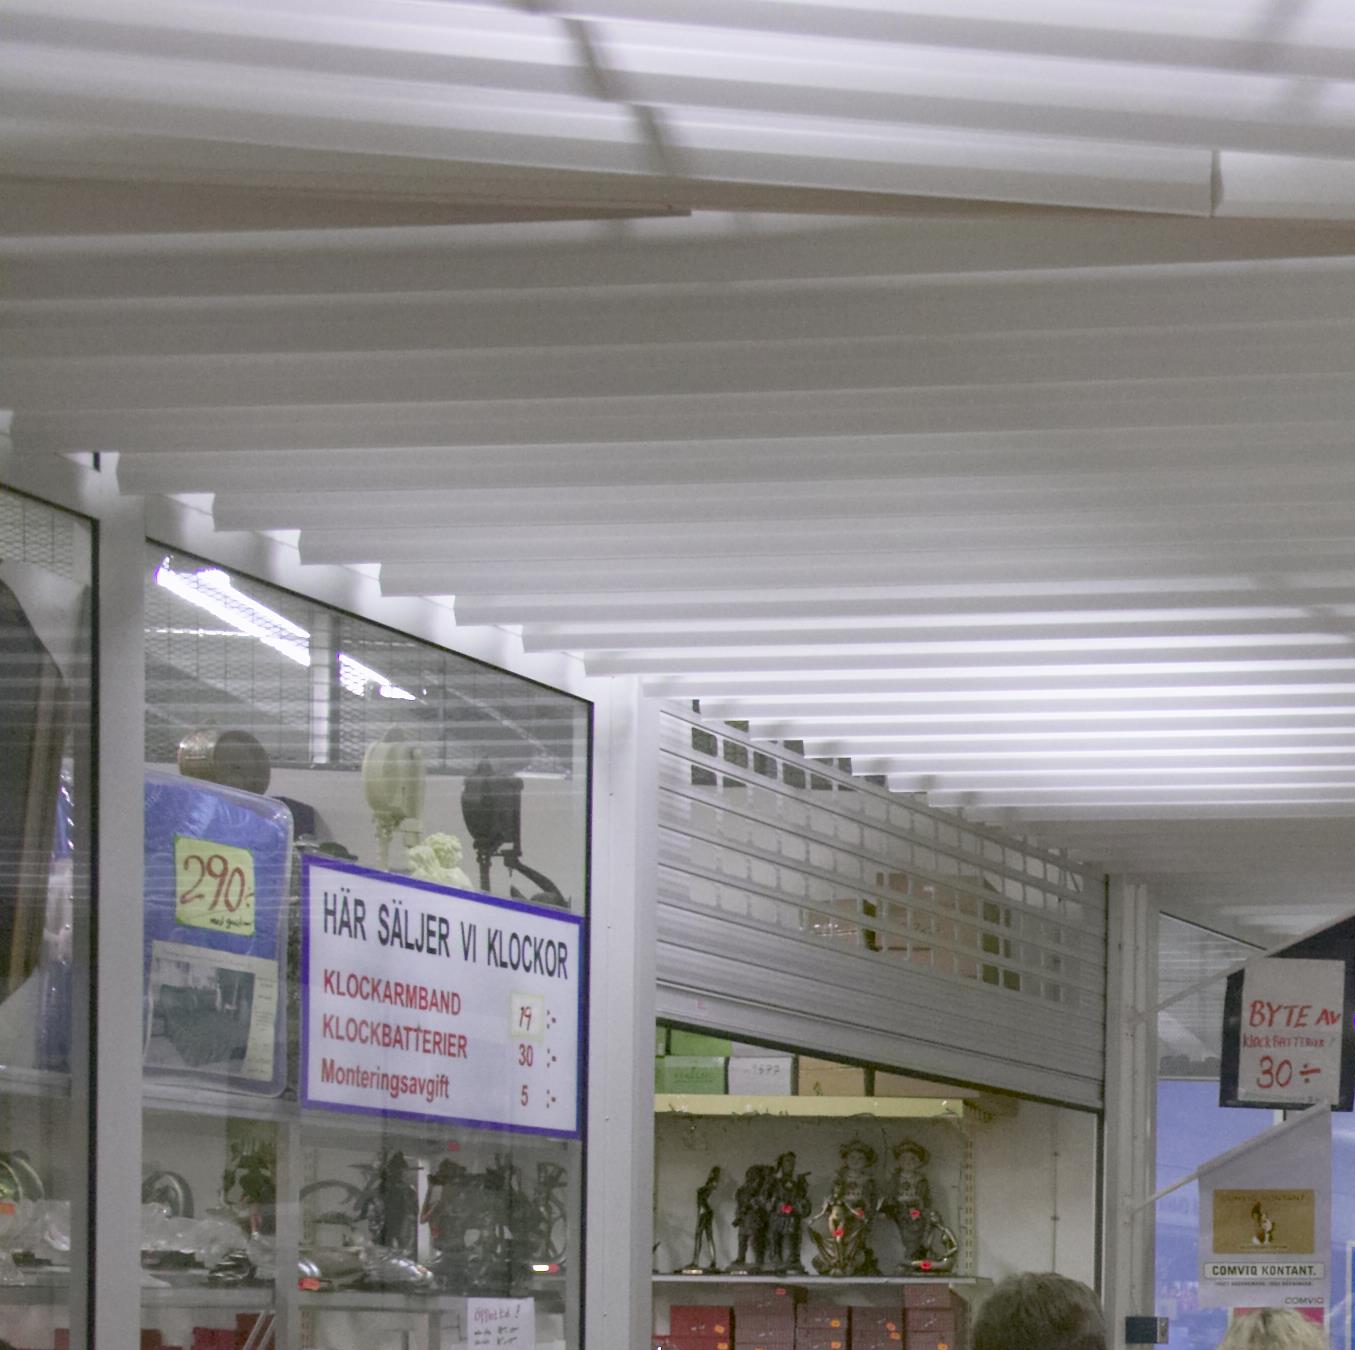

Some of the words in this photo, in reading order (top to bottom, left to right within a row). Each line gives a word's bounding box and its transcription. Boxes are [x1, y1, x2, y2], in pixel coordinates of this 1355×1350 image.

[323, 887, 368, 941] HÄR
[377, 898, 451, 958] SÄLJER
[460, 920, 477, 963] VI
[487, 926, 569, 980] KLOCKOR
[323, 968, 462, 1016] KLOCKARMBAND
[1249, 1000, 1313, 1028] BYTE
[322, 1013, 468, 1060] KLOCKBATTERIER
[518, 1043, 534, 1068] 30
[320, 1057, 450, 1103] Monteringsavgift
[520, 1084, 529, 1106] 5
[1256, 1055, 1293, 1089] 30
[1212, 1265, 1258, 1276] COMVIQ
[1261, 1265, 1317, 1276] KONTANT.
[1284, 1296, 1325, 1305] COMVIQ
